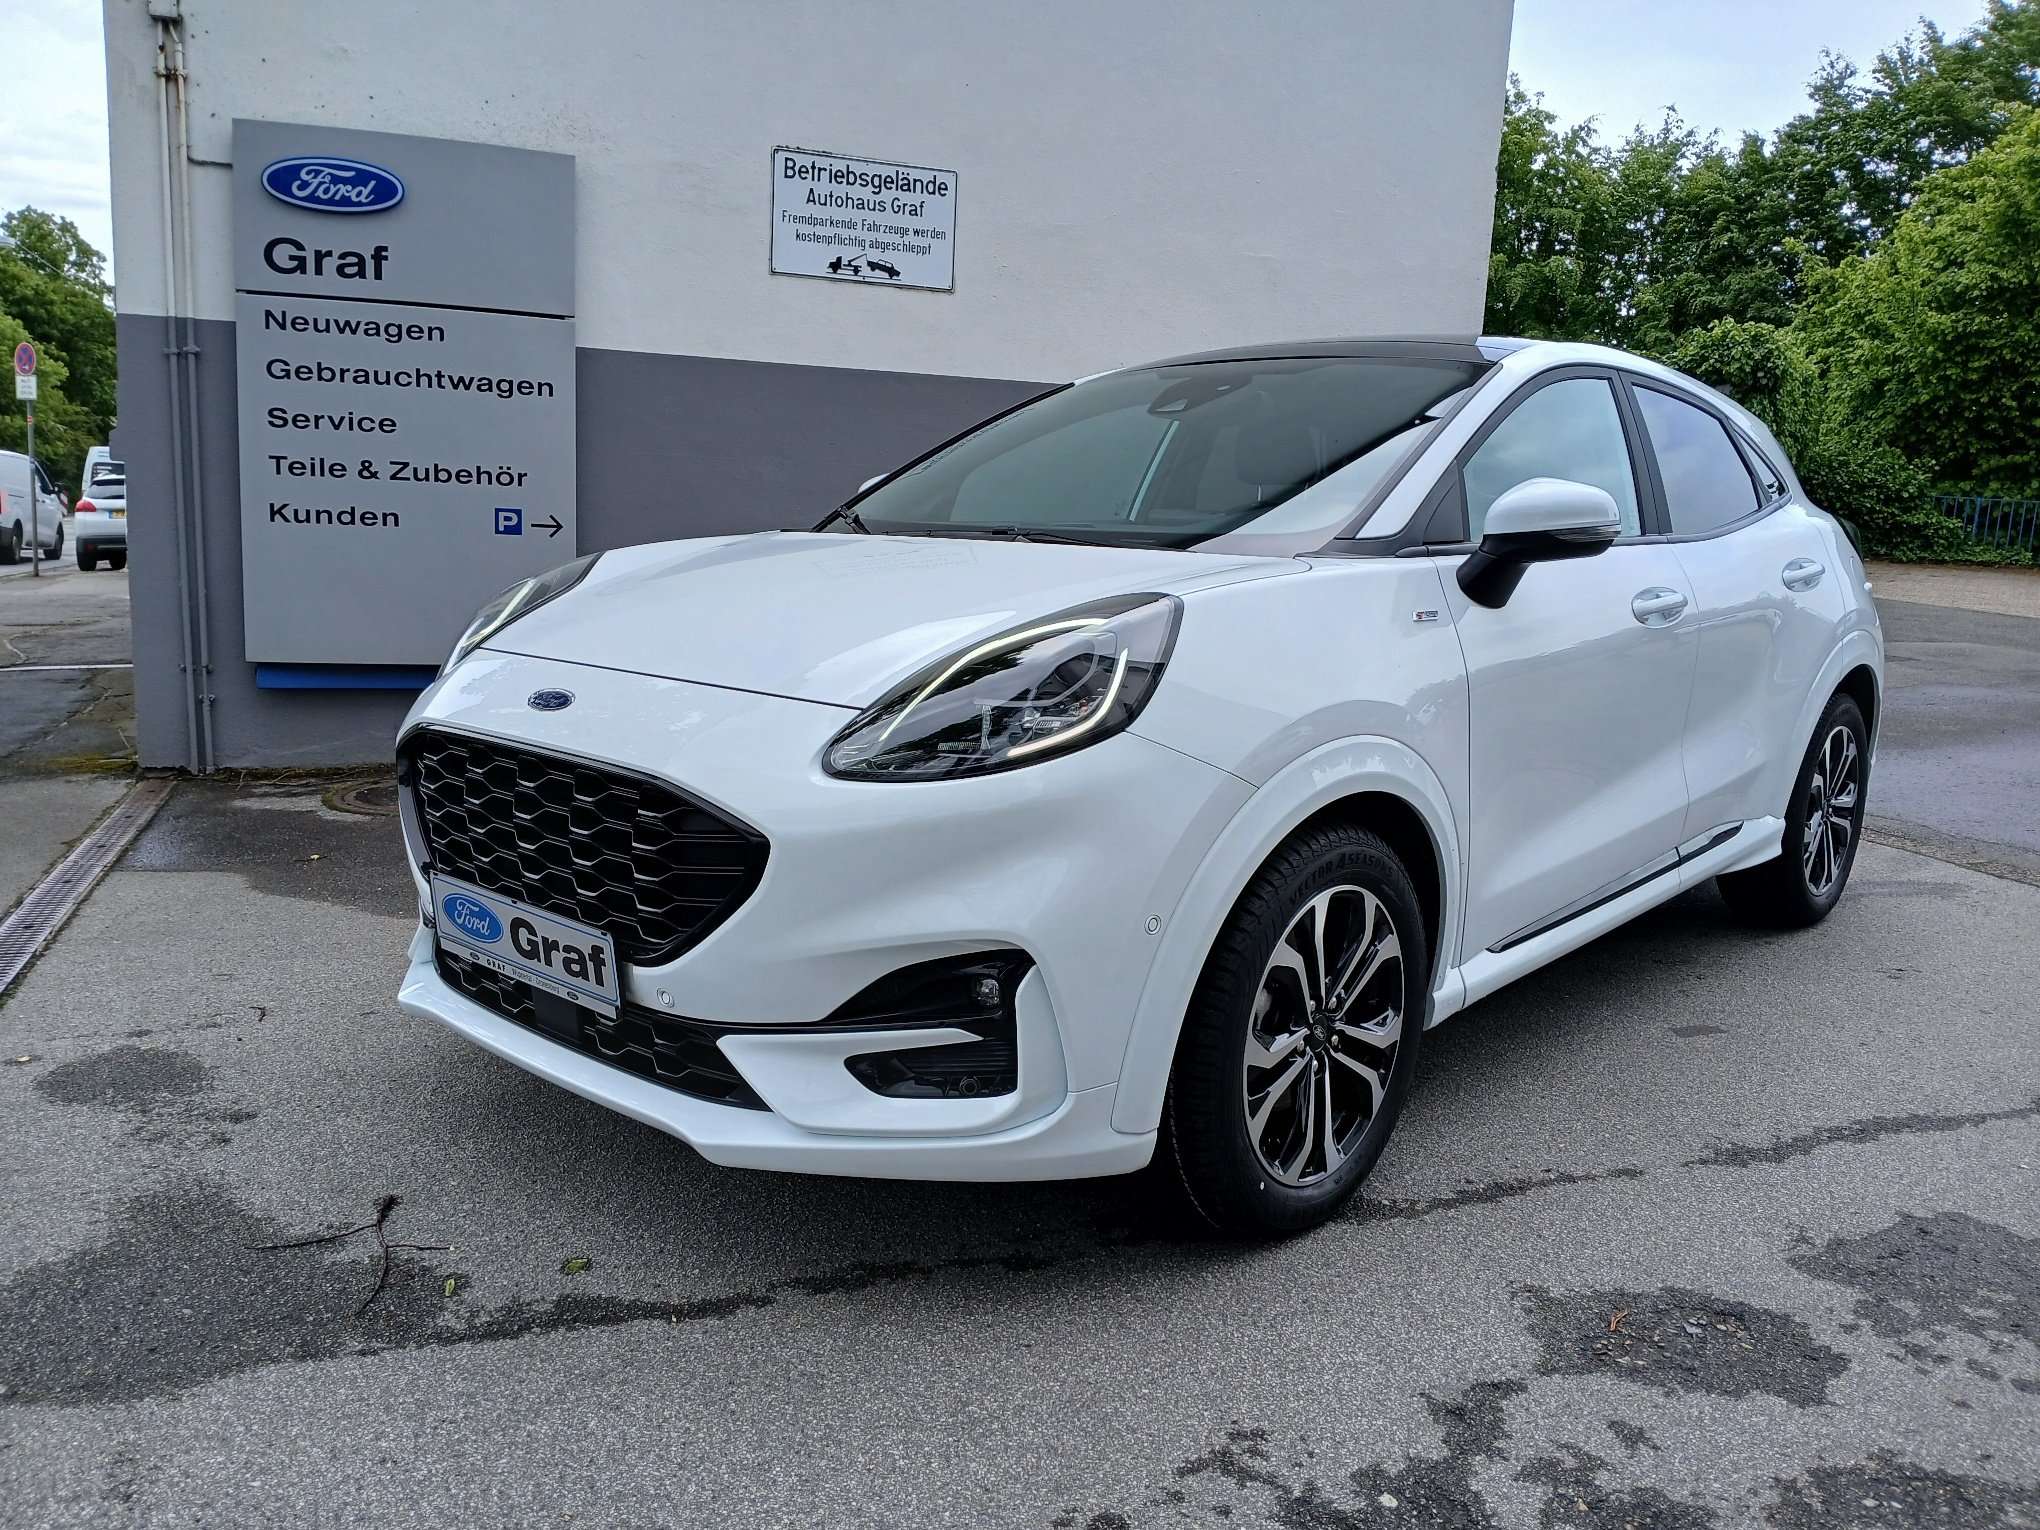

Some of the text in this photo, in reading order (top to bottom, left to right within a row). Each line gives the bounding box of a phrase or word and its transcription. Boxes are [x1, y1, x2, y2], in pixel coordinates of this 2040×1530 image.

[291, 165, 376, 203] Ford
[783, 156, 949, 197] Betriebsgelände
[805, 187, 925, 218] Autohaus Graf
[782, 209, 946, 241] Fremdparkende Fahrzeuge werden
[795, 228, 932, 257] kostenpflichtig abgeschleppt
[263, 237, 389, 281] Graf
[264, 309, 446, 344] Neuwagen
[265, 358, 555, 399] Gebrauchtwagen
[267, 407, 398, 434] Service
[268, 455, 528, 487] Teile & Zubehör
[268, 502, 519, 532] Kunden P
[454, 900, 491, 936] Ford
[509, 916, 607, 988] Graf
[486, 959, 506, 972] GRAF
